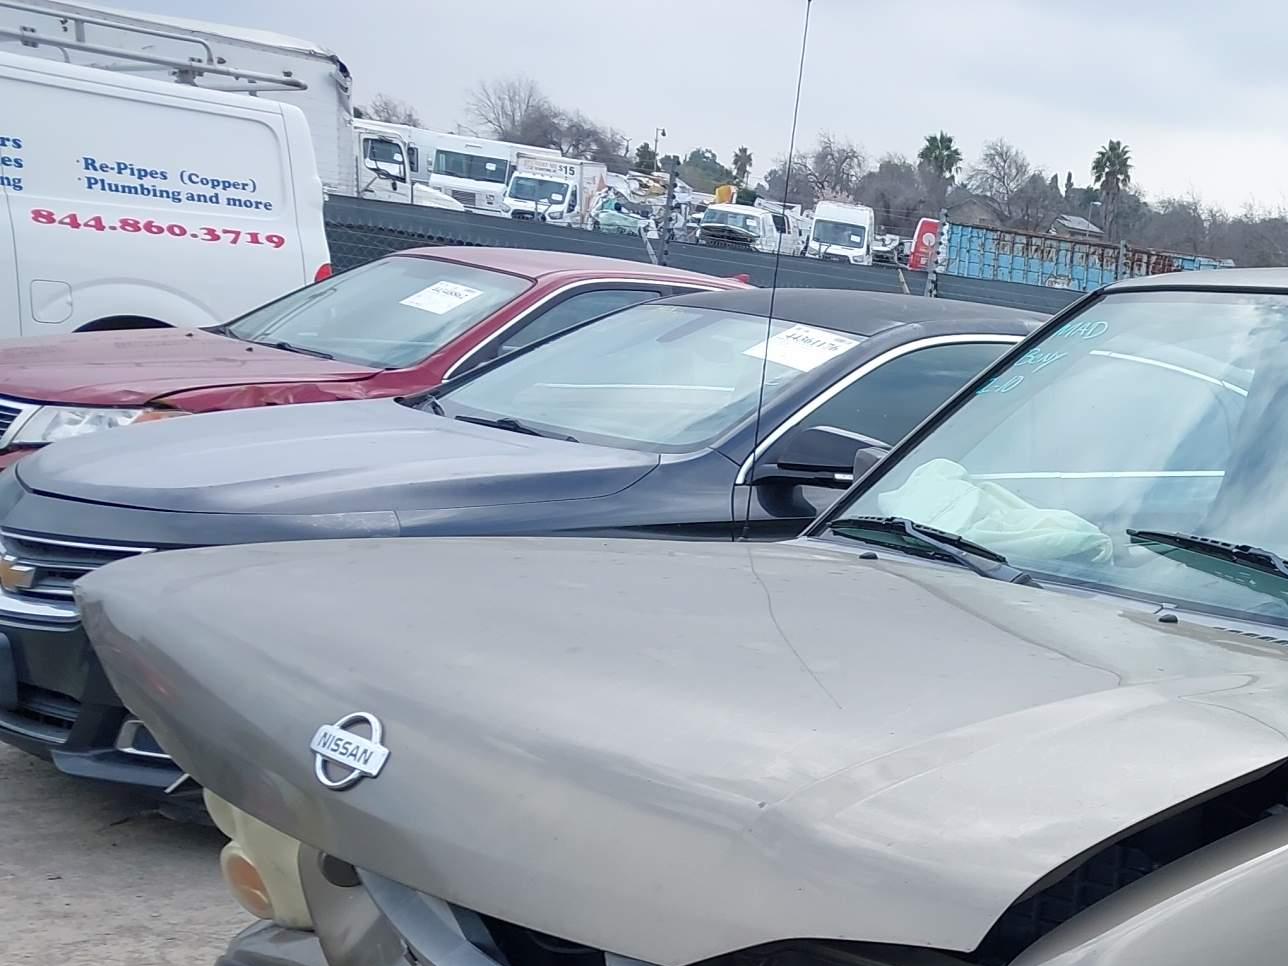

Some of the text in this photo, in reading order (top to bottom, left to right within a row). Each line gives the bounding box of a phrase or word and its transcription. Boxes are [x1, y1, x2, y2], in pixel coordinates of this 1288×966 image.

[82, 157, 257, 193] Re-Pipes (Copper)
[86, 176, 273, 211] Plumbing and more
[31, 208, 286, 249] 844.860.3719
[317, 732, 373, 765] NISSAN
